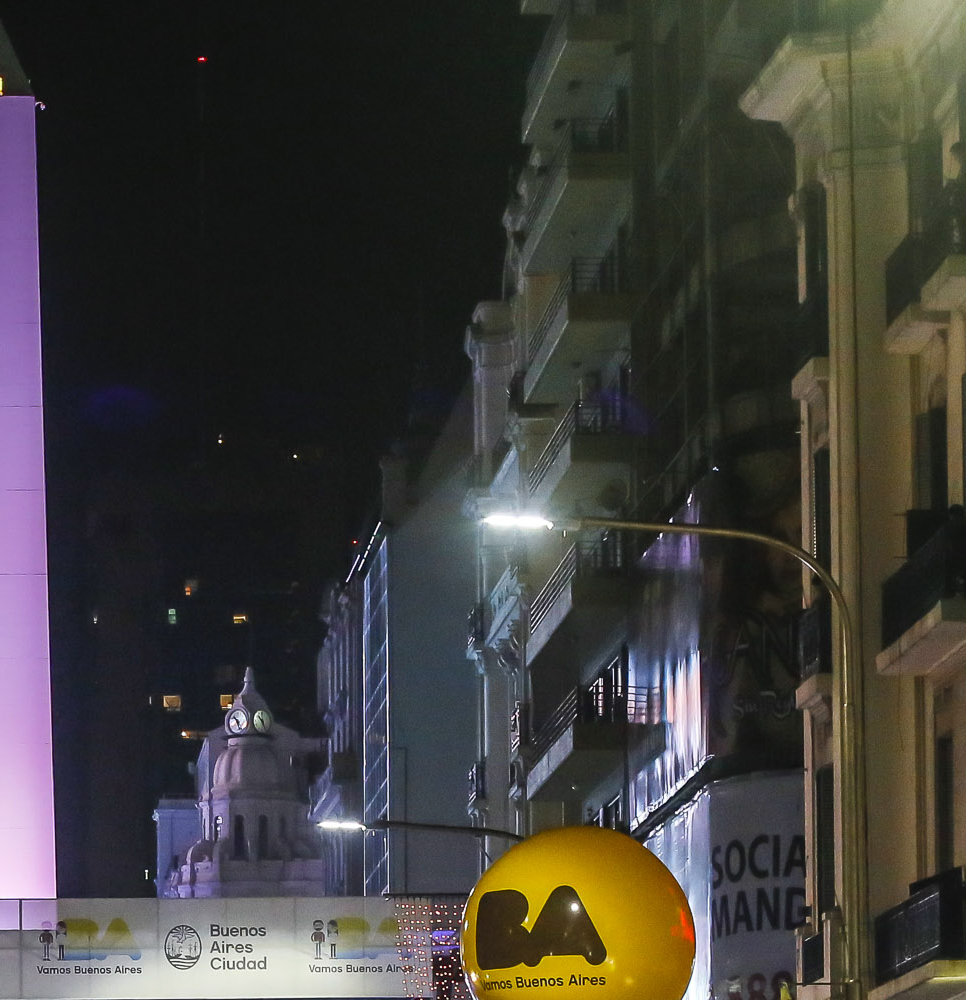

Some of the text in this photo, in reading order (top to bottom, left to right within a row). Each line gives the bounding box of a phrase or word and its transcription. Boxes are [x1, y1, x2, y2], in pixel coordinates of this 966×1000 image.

[210, 924, 267, 937] Buenos
[210, 941, 254, 954] Aires
[36, 965, 142, 974] Vamos Buenos Aires
[210, 956, 267, 970] Ciudad
[309, 964, 343, 973] Vamos
[346, 964, 384, 973] Buenos
[481, 974, 606, 991] Vamos Buenos Aires
